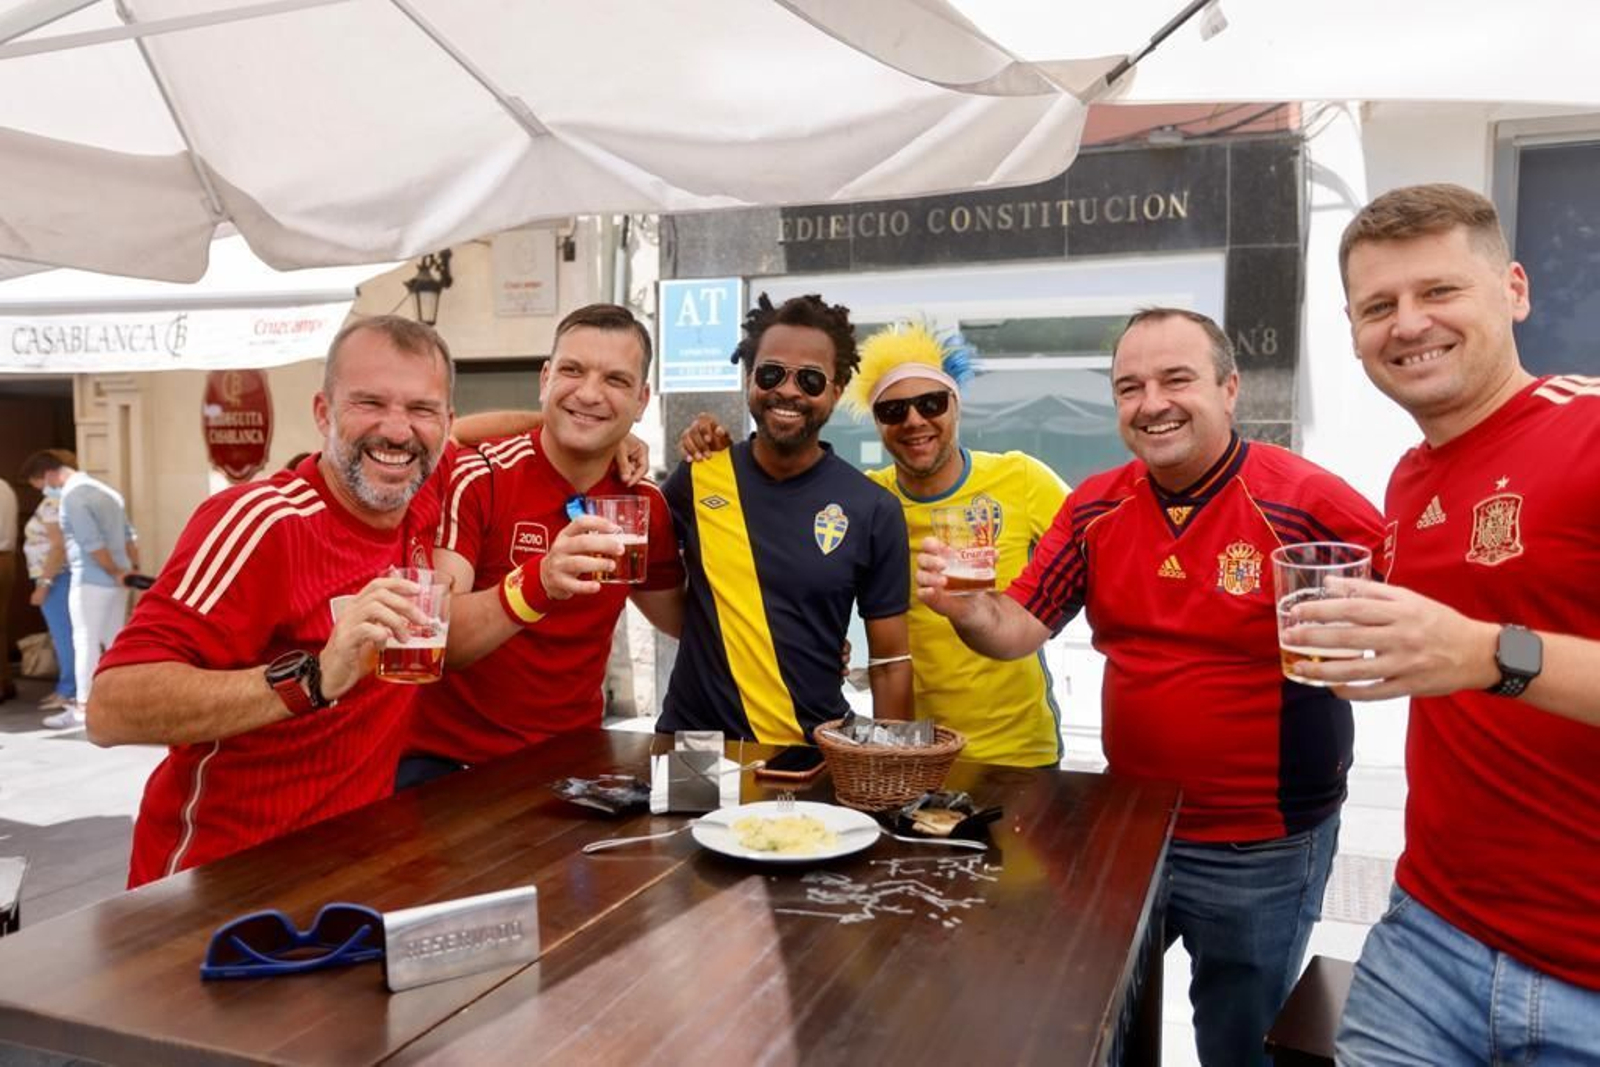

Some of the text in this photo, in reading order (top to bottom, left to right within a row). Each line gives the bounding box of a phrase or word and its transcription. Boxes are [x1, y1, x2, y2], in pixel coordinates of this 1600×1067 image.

[778, 191, 1189, 241] EDIFICIO CONSTITUCION
[675, 288, 727, 327] AT
[12, 324, 158, 355] CASABLANCA
[518, 532, 543, 546] 2010
